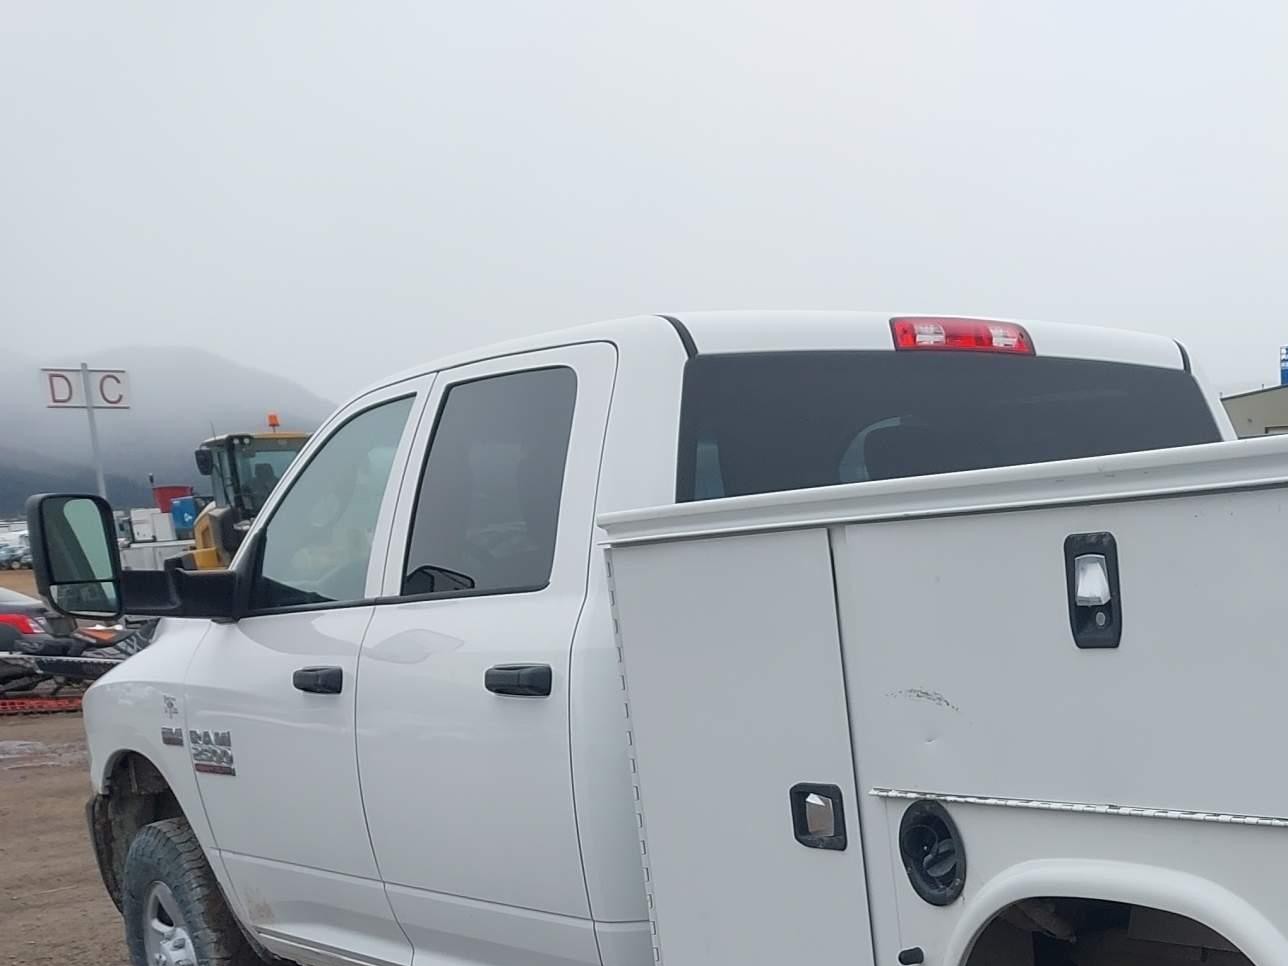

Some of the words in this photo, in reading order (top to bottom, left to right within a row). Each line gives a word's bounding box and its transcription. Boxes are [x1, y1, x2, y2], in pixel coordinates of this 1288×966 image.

[48, 373, 73, 404] D
[99, 374, 124, 405] C
[189, 730, 232, 747] RAM
